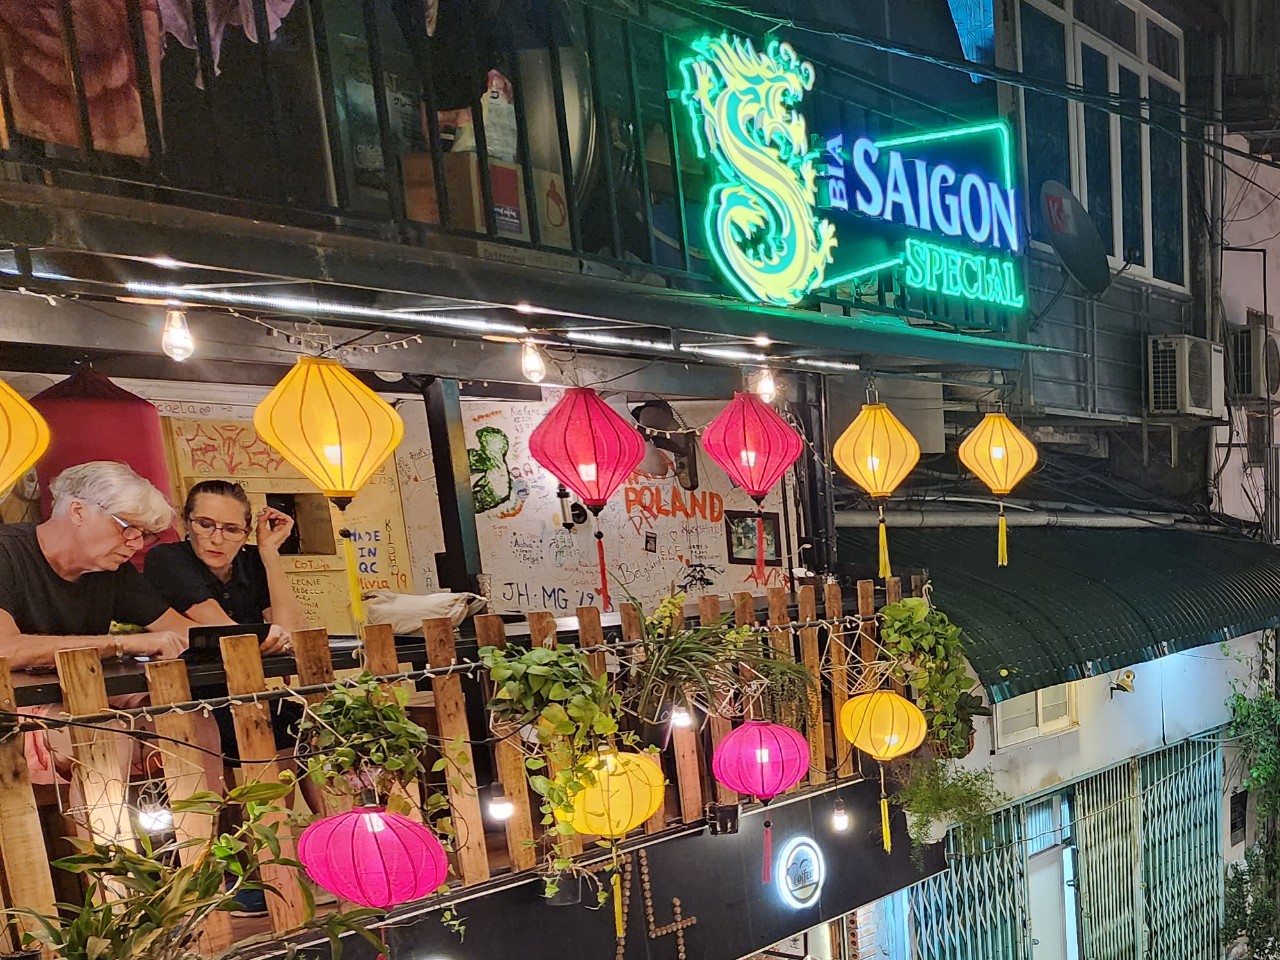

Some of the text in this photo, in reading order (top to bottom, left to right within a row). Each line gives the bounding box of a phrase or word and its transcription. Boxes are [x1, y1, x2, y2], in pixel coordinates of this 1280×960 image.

[826, 134, 849, 211] BIA
[853, 137, 1018, 252] SAIGON
[905, 237, 1024, 307] SPECIAL
[624, 485, 724, 523] POLAND
[358, 547, 378, 558] IN
[358, 562, 379, 573] QC
